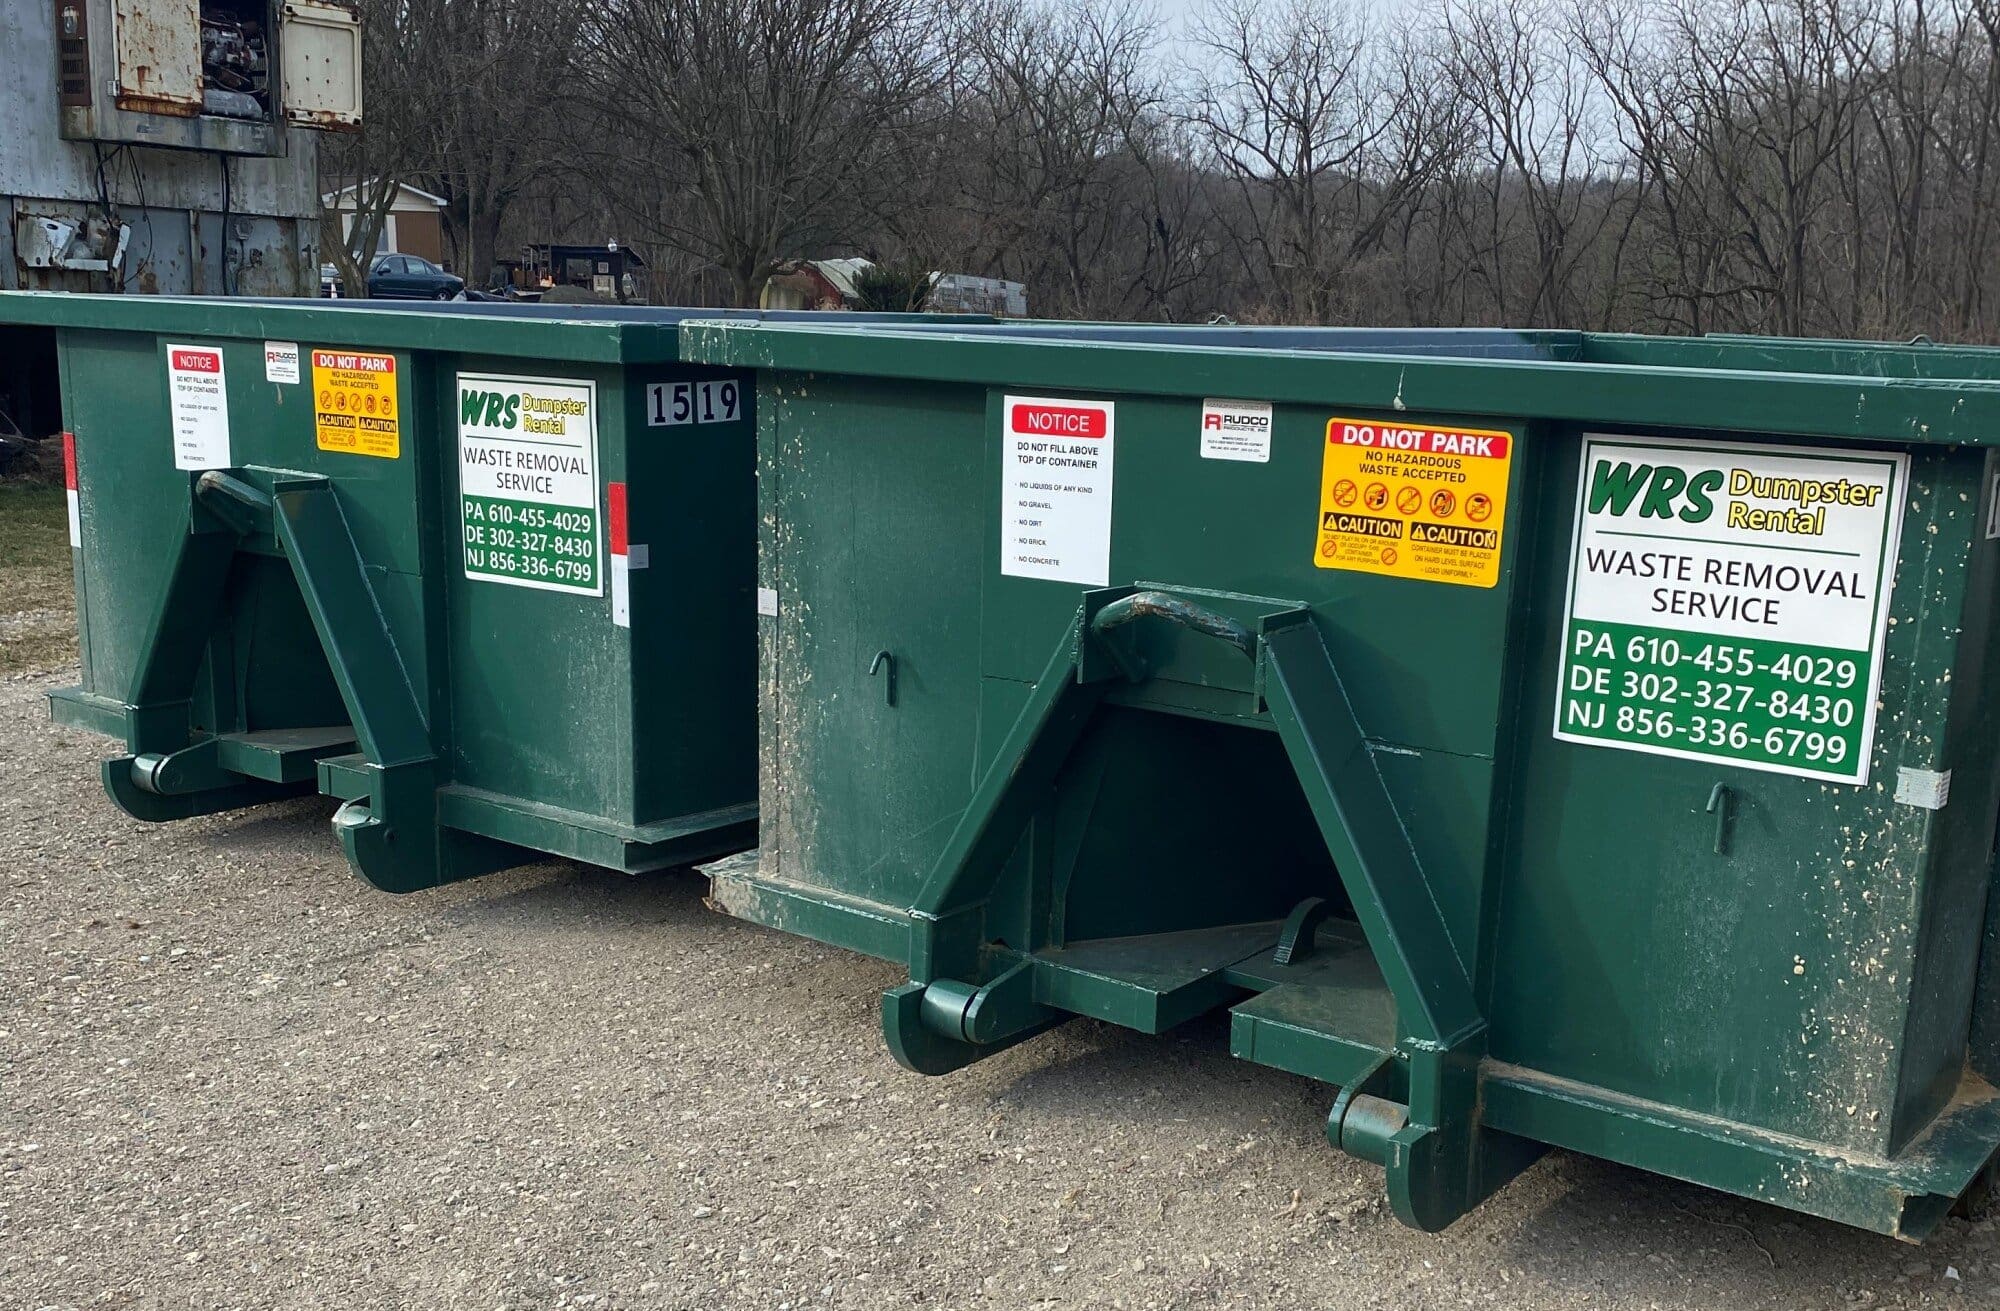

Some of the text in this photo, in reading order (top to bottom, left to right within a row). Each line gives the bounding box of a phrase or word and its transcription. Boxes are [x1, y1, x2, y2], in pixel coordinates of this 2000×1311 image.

[180, 355, 212, 369] NOTICE
[320, 355, 387, 371] DO NOT PARK
[341, 372, 376, 380] HAZARDOUS
[350, 381, 379, 390] ACCEPTED
[461, 389, 520, 429] WRS
[522, 393, 586, 416] Dumpster
[654, 383, 737, 423] 1519
[325, 415, 355, 428] CAUTION
[366, 418, 396, 432] CAUTION
[523, 414, 565, 435] Rental
[1027, 412, 1090, 432] NOTICE
[1224, 415, 1269, 426] RUDCO
[1017, 441, 1099, 456] DO NOT FILL ABOVE
[1342, 425, 1493, 457] DO NOT PARK
[463, 447, 588, 475] WASTE REMOVAL
[1017, 454, 1098, 469] TOP OF CONTAINER
[1366, 451, 1461, 469] NO HAZARDOUS
[496, 472, 553, 494] SERVICE
[1359, 463, 1466, 483] WASTE ACCEPTED
[1030, 482, 1053, 491] LIQUIDS
[1588, 459, 1724, 523] WRS
[1728, 468, 1882, 508] Dumpster
[1029, 501, 1053, 509] GRAVEL
[465, 502, 591, 533] PA 610-455-4029
[1338, 516, 1402, 538] CAUTION
[1727, 502, 1826, 536] Rental
[466, 527, 592, 558] DE 302-327-8430
[1029, 538, 1046, 546] BRICK
[1426, 526, 1496, 548] CAUTION
[1028, 557, 1060, 566] CONCRETE
[1411, 544, 1442, 553] CONTAINER
[1469, 550, 1491, 560] PLACED
[467, 548, 592, 582] NJ 856-336-6799
[1441, 558, 1457, 566] LEVEL
[1459, 560, 1485, 569] SURFACE
[1586, 547, 1866, 599] WASTE REMOVAL
[1651, 587, 1781, 625] SERVICE
[1575, 629, 1856, 689] PA 610-455-4029
[1570, 664, 1854, 728] DE 302-327-8430
[1567, 699, 1847, 764] NJ 856-336-6799
